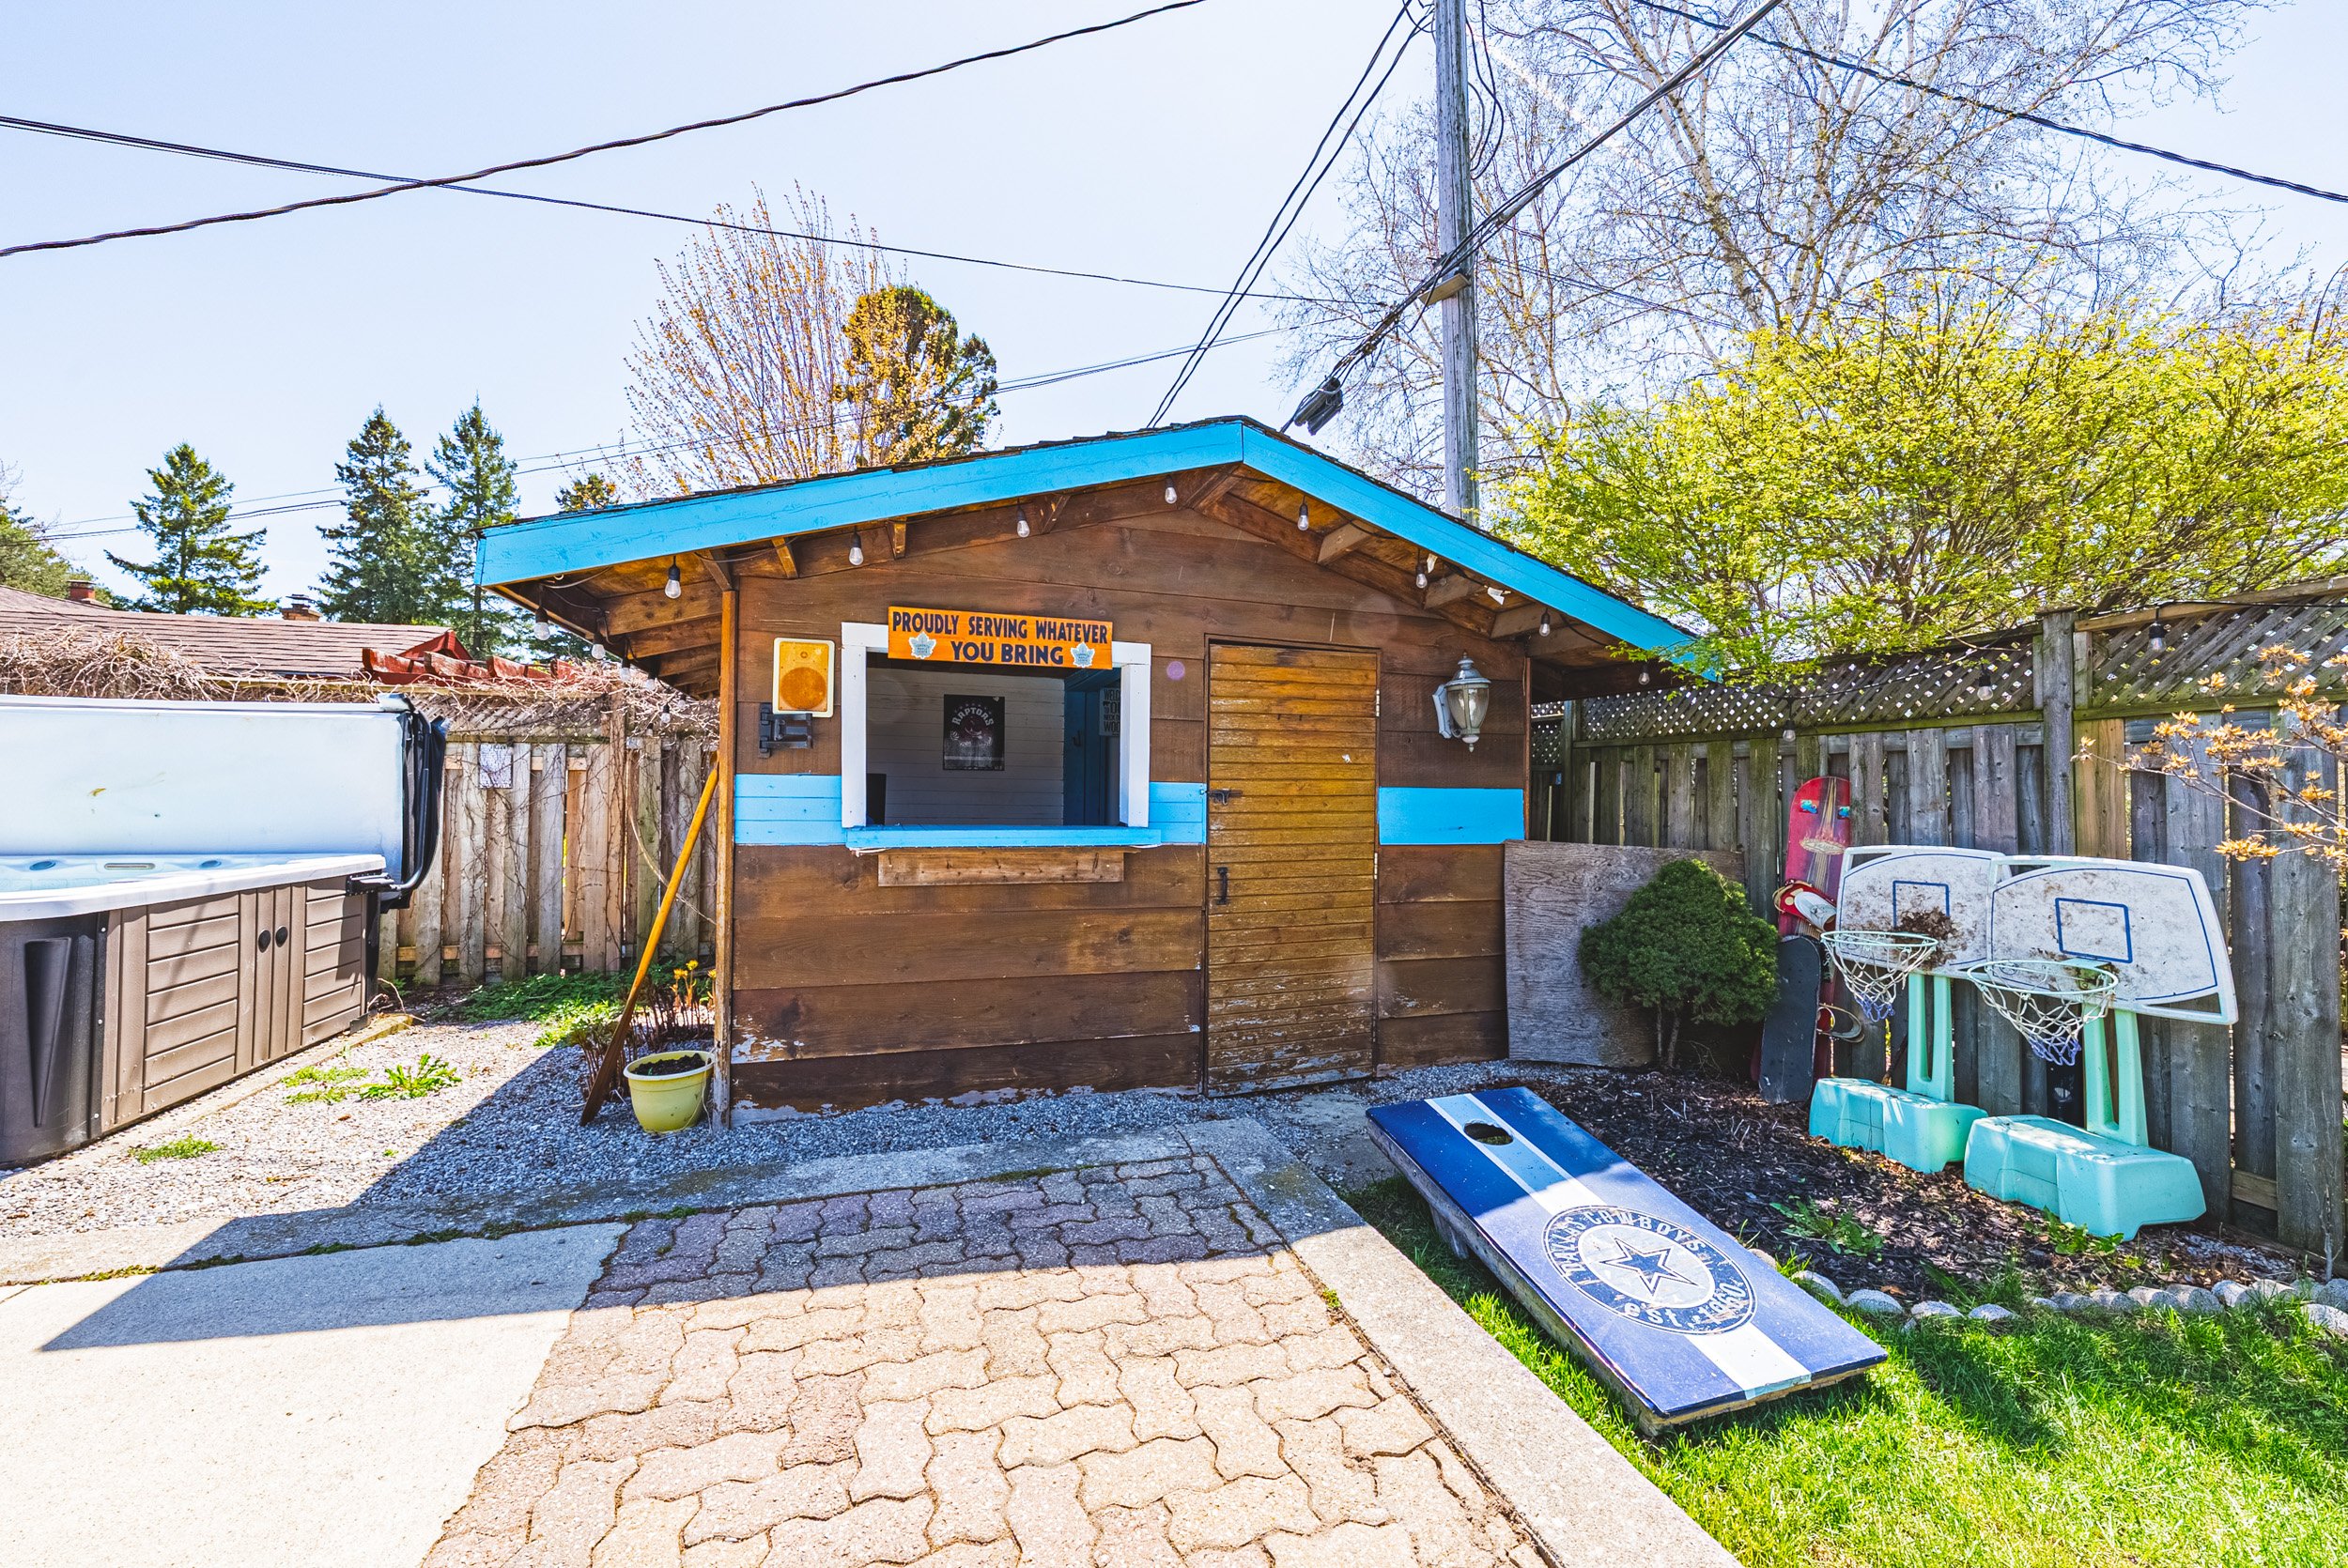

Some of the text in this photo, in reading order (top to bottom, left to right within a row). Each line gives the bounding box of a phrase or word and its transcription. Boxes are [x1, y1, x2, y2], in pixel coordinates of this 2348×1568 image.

[892, 611, 1107, 644] PROUDLY SERVING WHATEVER
[950, 640, 994, 662] YOU
[1001, 643, 1063, 665] BRING
[951, 707, 995, 726] RAPTORS
[1583, 1209, 1707, 1253] COWBOYS
